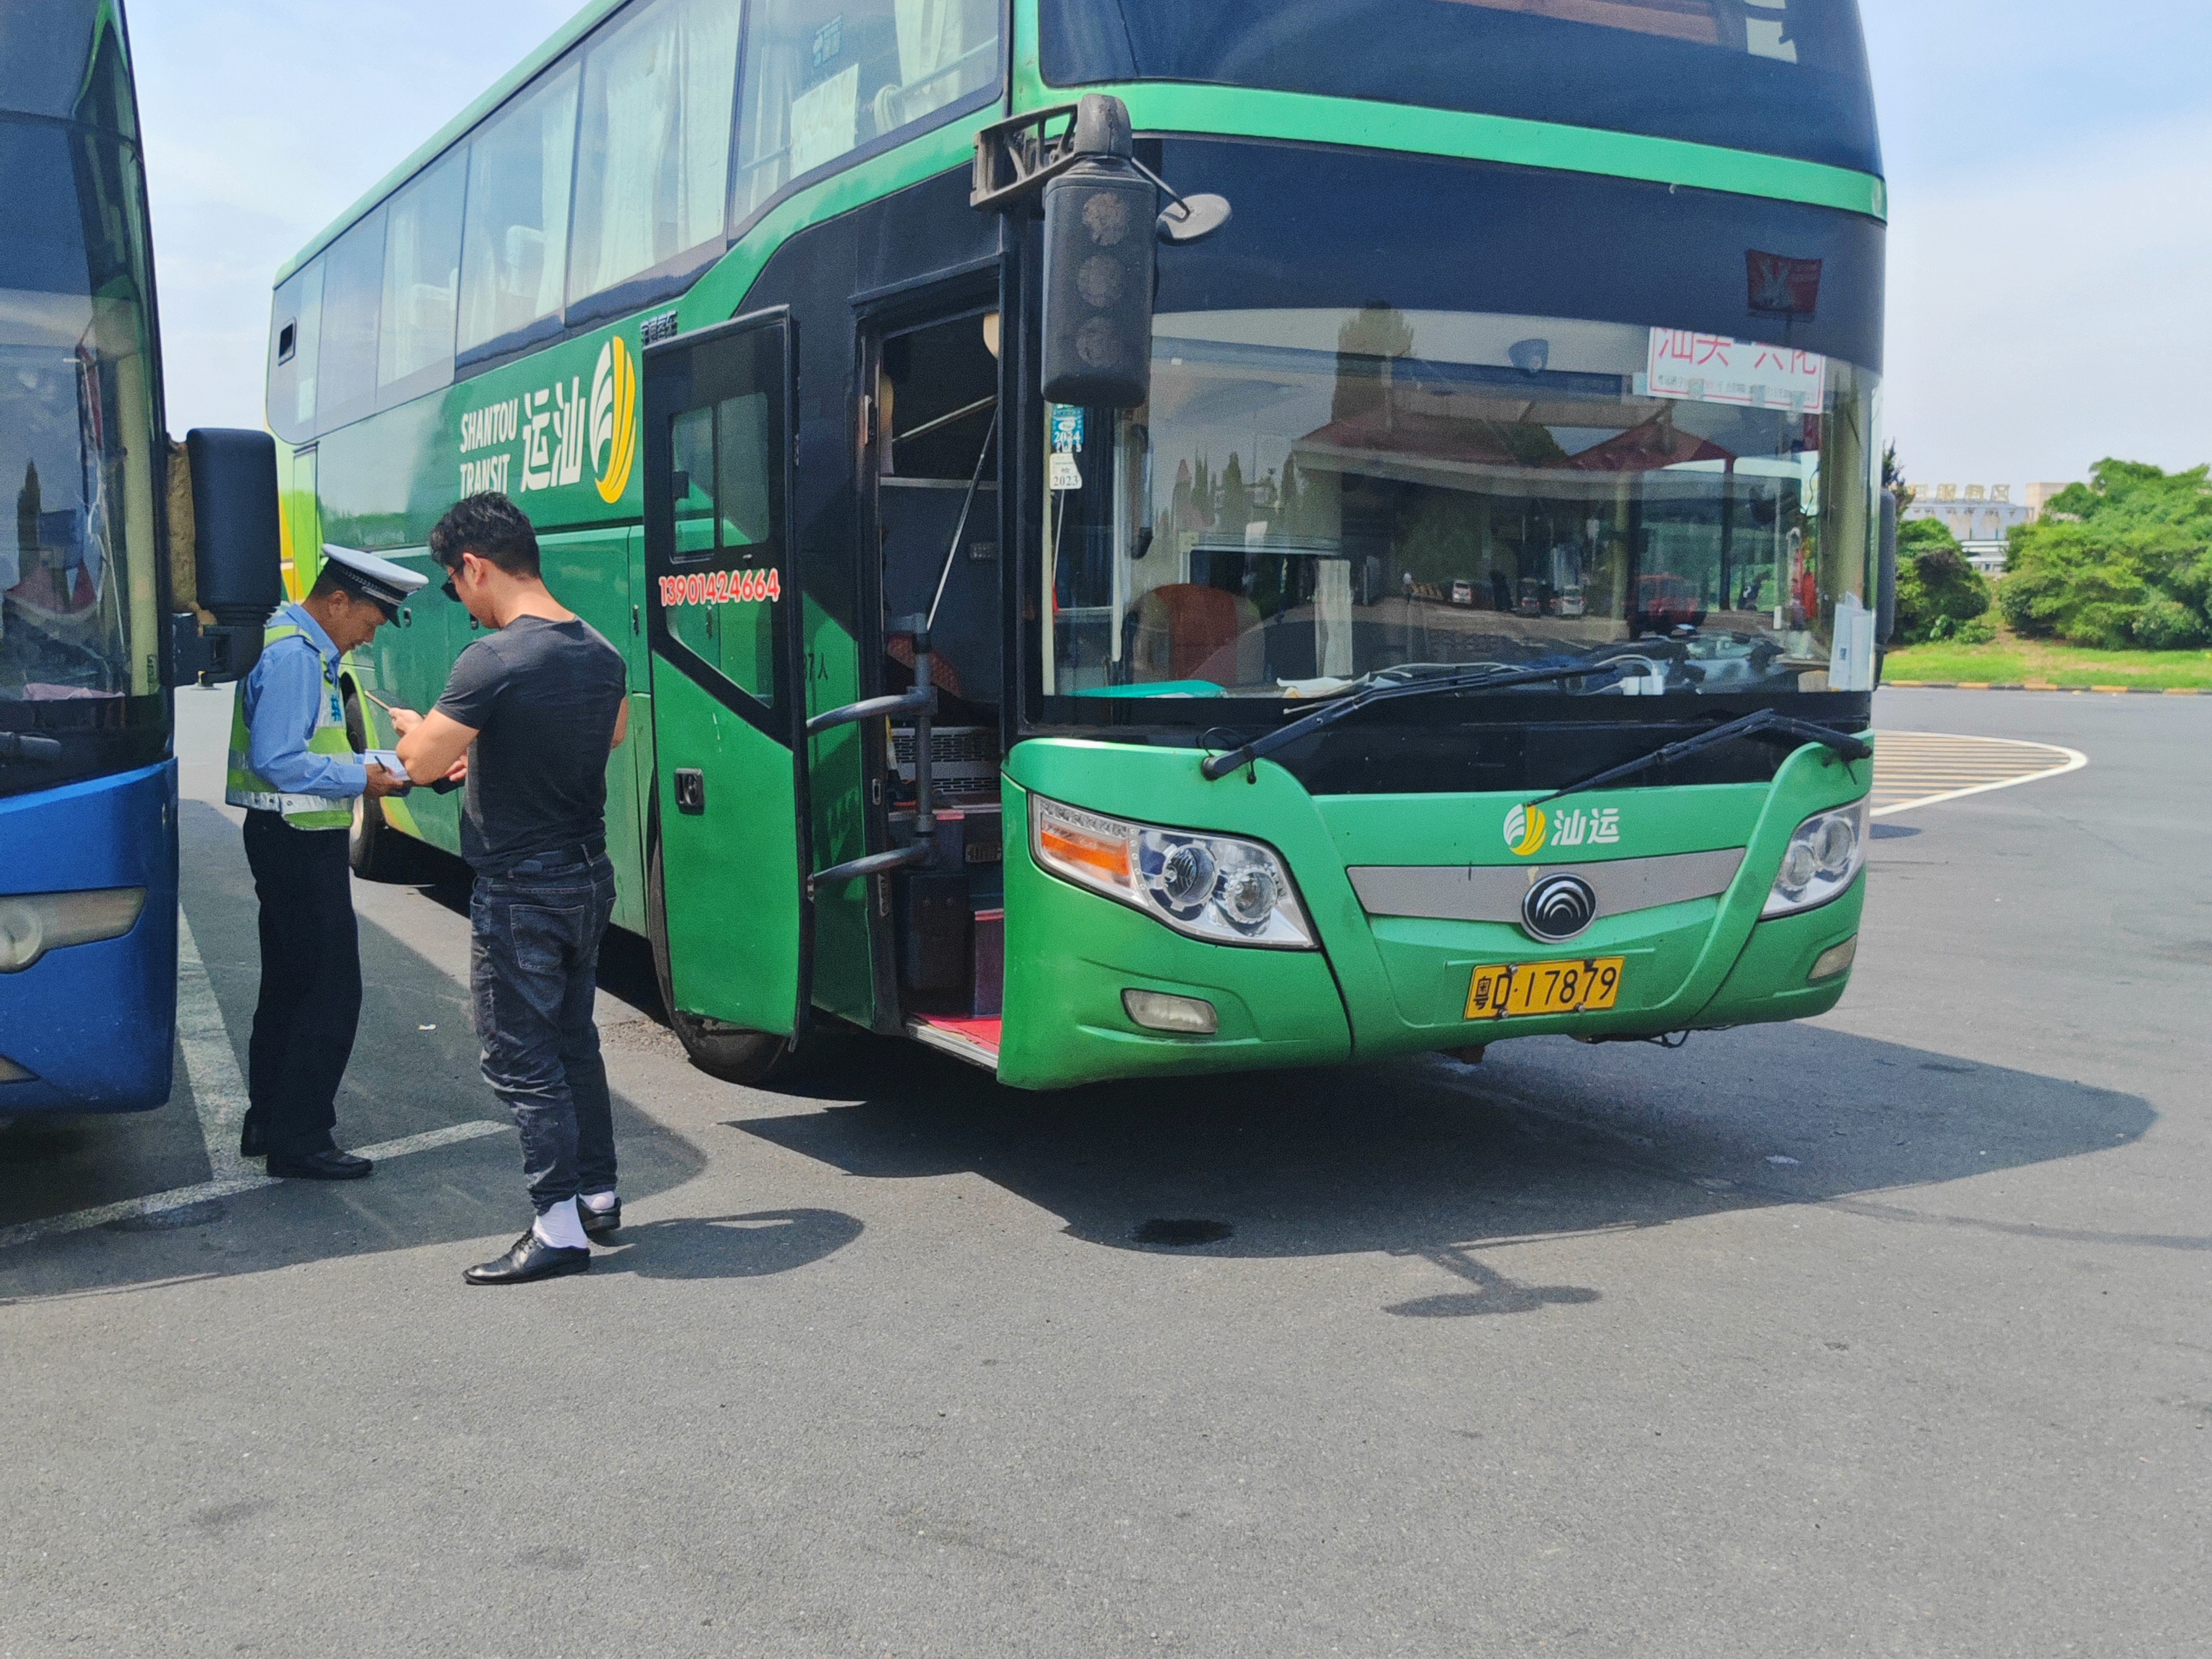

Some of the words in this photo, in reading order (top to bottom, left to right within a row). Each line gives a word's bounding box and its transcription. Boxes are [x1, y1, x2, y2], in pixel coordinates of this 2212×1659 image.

[460, 398, 518, 453] SHANTOU
[460, 454, 511, 500] TRANSIT
[1053, 475, 1079, 487] 2023
[659, 567, 781, 607] 13901424664
[1550, 808, 1620, 845] 汕运
